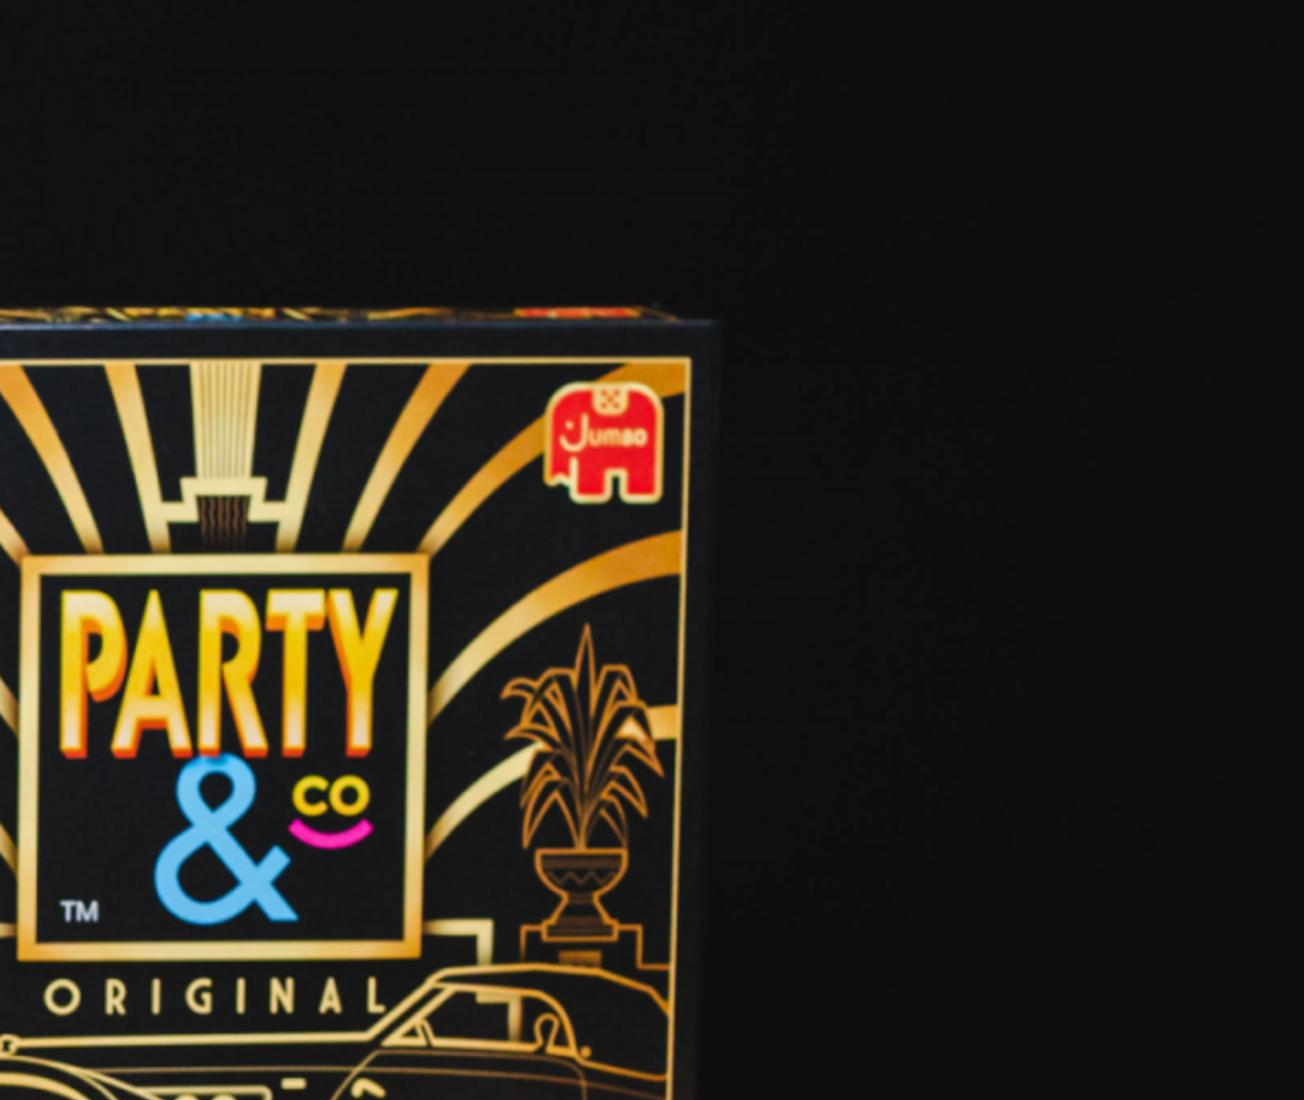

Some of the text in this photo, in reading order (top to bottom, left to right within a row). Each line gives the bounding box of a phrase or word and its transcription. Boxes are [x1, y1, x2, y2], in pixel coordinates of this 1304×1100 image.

[60, 588, 399, 759] PARTY
[154, 752, 371, 926] & CO
[60, 900, 99, 923] TM
[43, 977, 387, 1016] ORIGINAL
